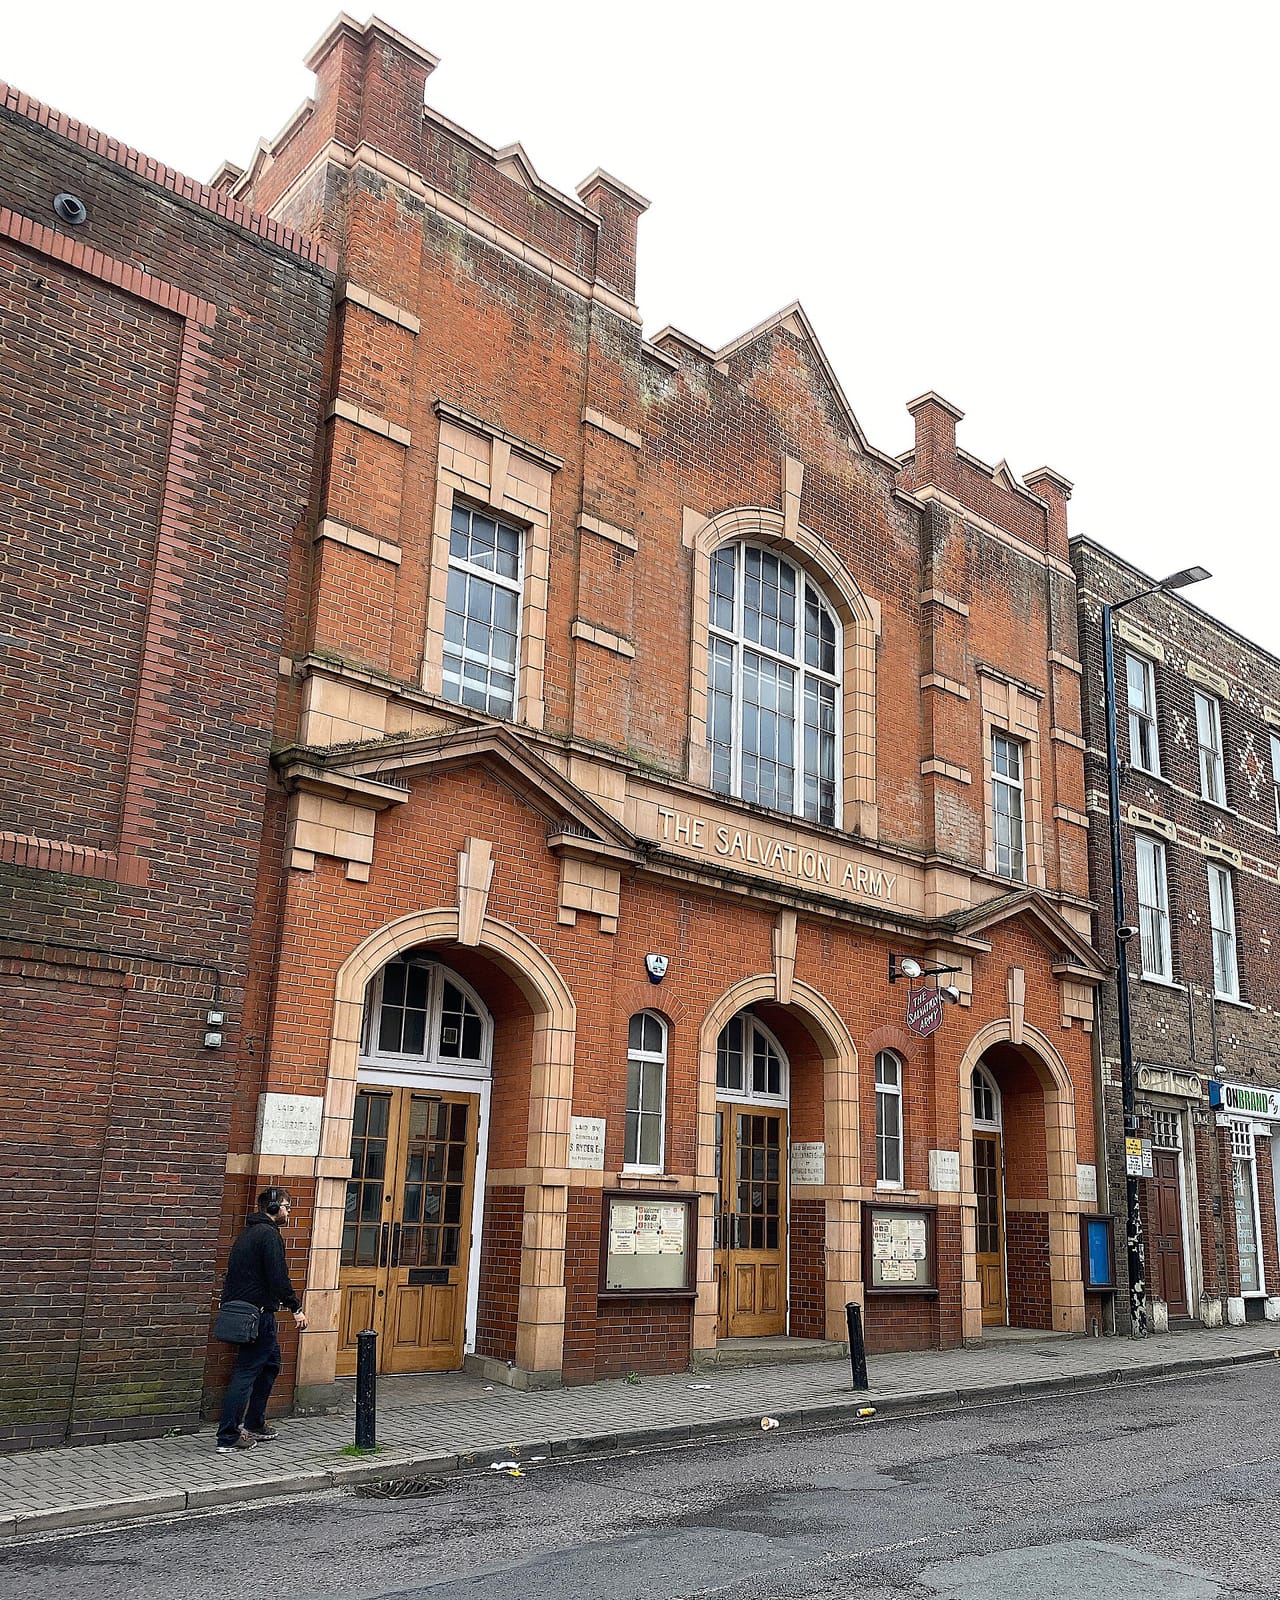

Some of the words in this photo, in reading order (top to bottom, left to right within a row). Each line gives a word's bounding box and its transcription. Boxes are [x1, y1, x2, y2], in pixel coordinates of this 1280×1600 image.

[658, 808, 705, 848] THE
[715, 827, 831, 883] SALVATION
[840, 863, 896, 899] ARMY
[912, 991, 927, 1008] THE
[919, 1007, 939, 1031] ARMY
[1225, 1086, 1268, 1113] ONBRAND
